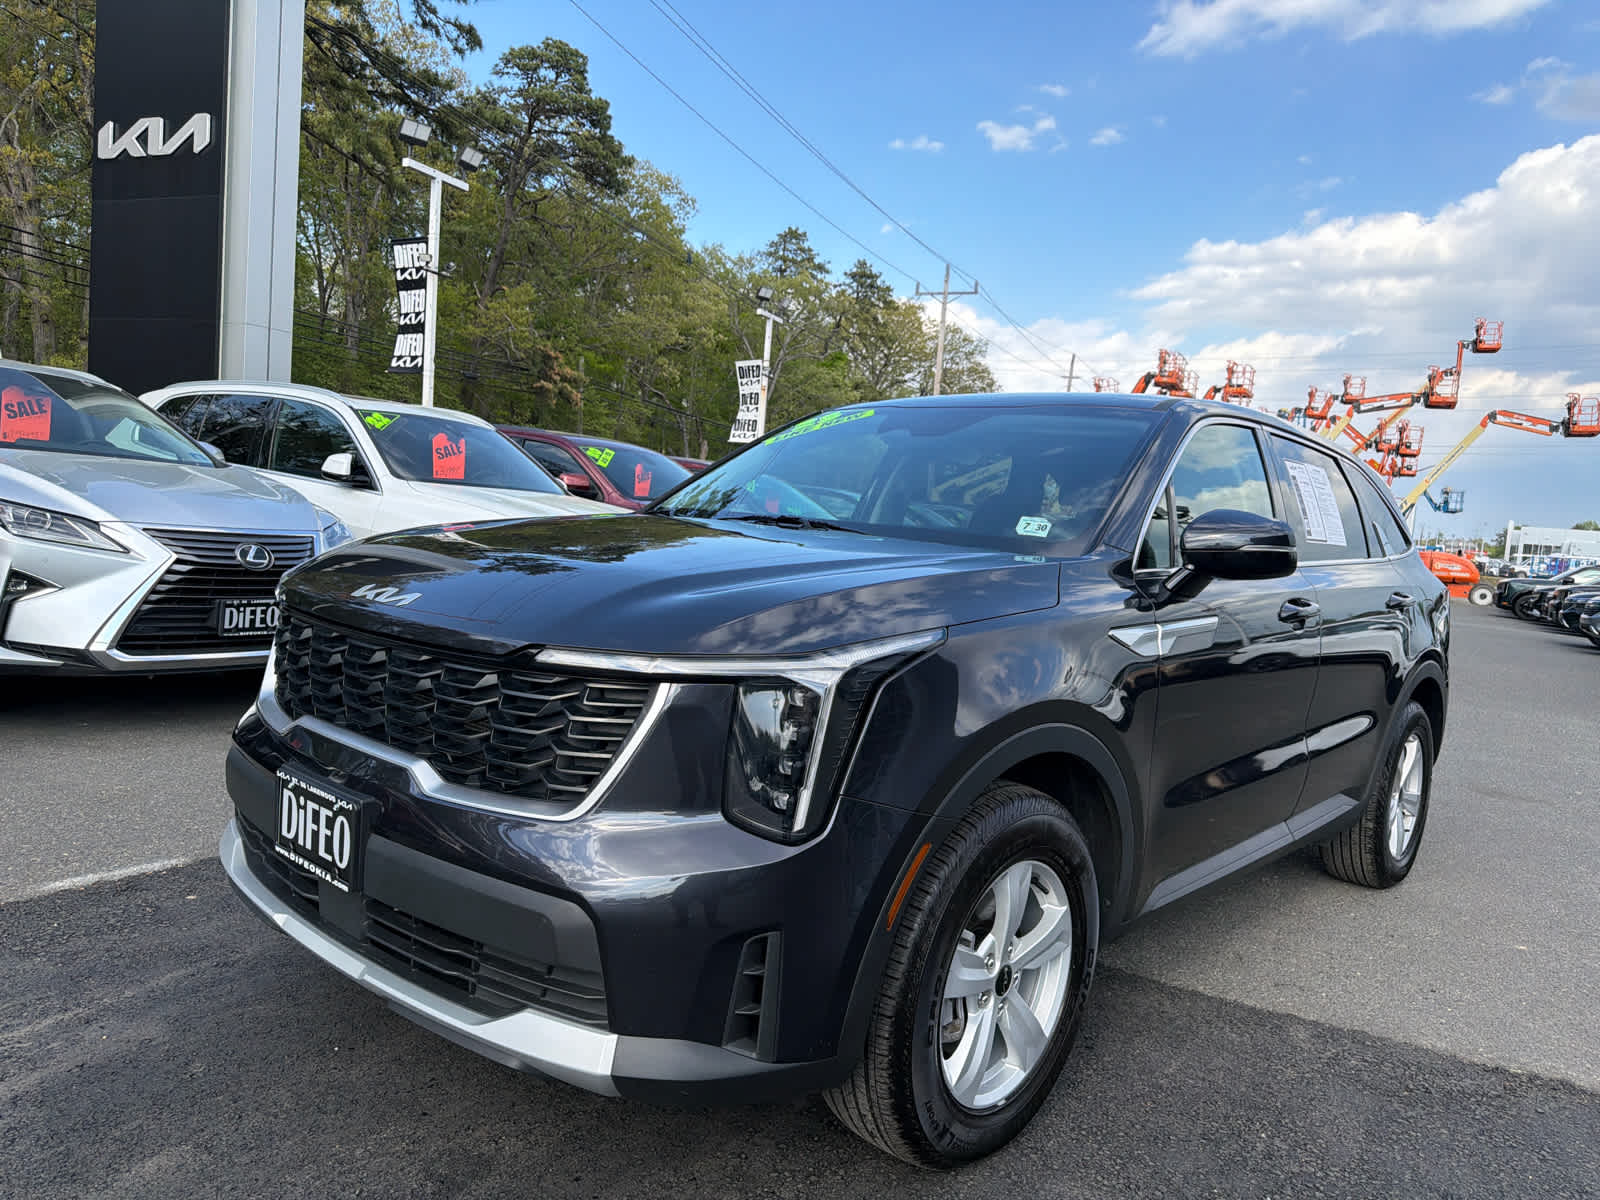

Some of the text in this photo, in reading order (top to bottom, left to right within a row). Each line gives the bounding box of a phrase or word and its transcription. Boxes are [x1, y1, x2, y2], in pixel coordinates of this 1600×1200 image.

[97, 112, 211, 159] KIA
[396, 268, 426, 280] KIA
[394, 333, 424, 356] DiFEO
[391, 356, 422, 368] KIA
[738, 365, 760, 379] DiFEO
[4, 398, 48, 419] SALE
[734, 419, 757, 432] DiFEO
[435, 443, 463, 460] SALE
[1024, 522, 1048, 531] 7 30
[350, 583, 423, 607] KIA
[224, 606, 280, 629] DiFEO
[281, 788, 350, 869] DiFEO
